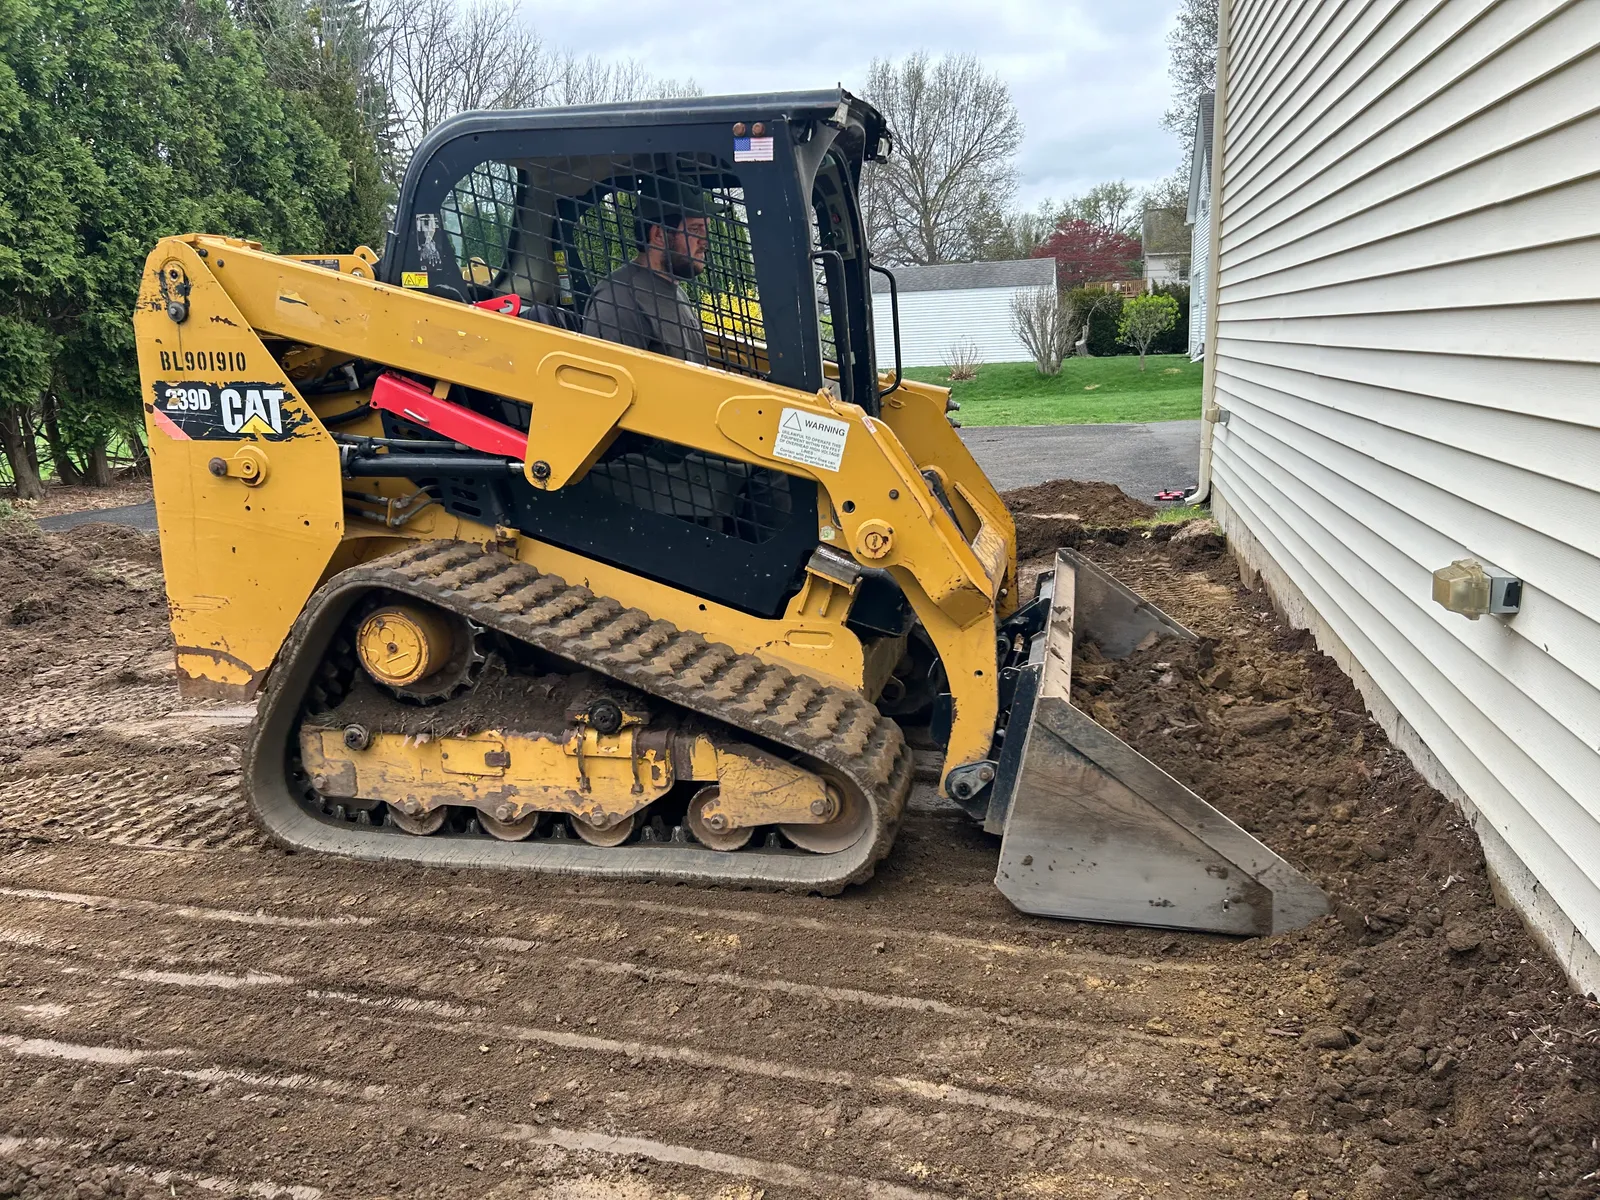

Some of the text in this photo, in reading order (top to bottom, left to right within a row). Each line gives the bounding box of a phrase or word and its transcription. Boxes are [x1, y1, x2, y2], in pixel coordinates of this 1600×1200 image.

[160, 351, 247, 372] BL901910
[220, 389, 284, 434] CAT
[804, 420, 845, 436] WARNING
[781, 434, 804, 443] EQUIPMENT
[786, 440, 809, 449] OVERHEAD
[812, 437, 831, 446] OPERATE
